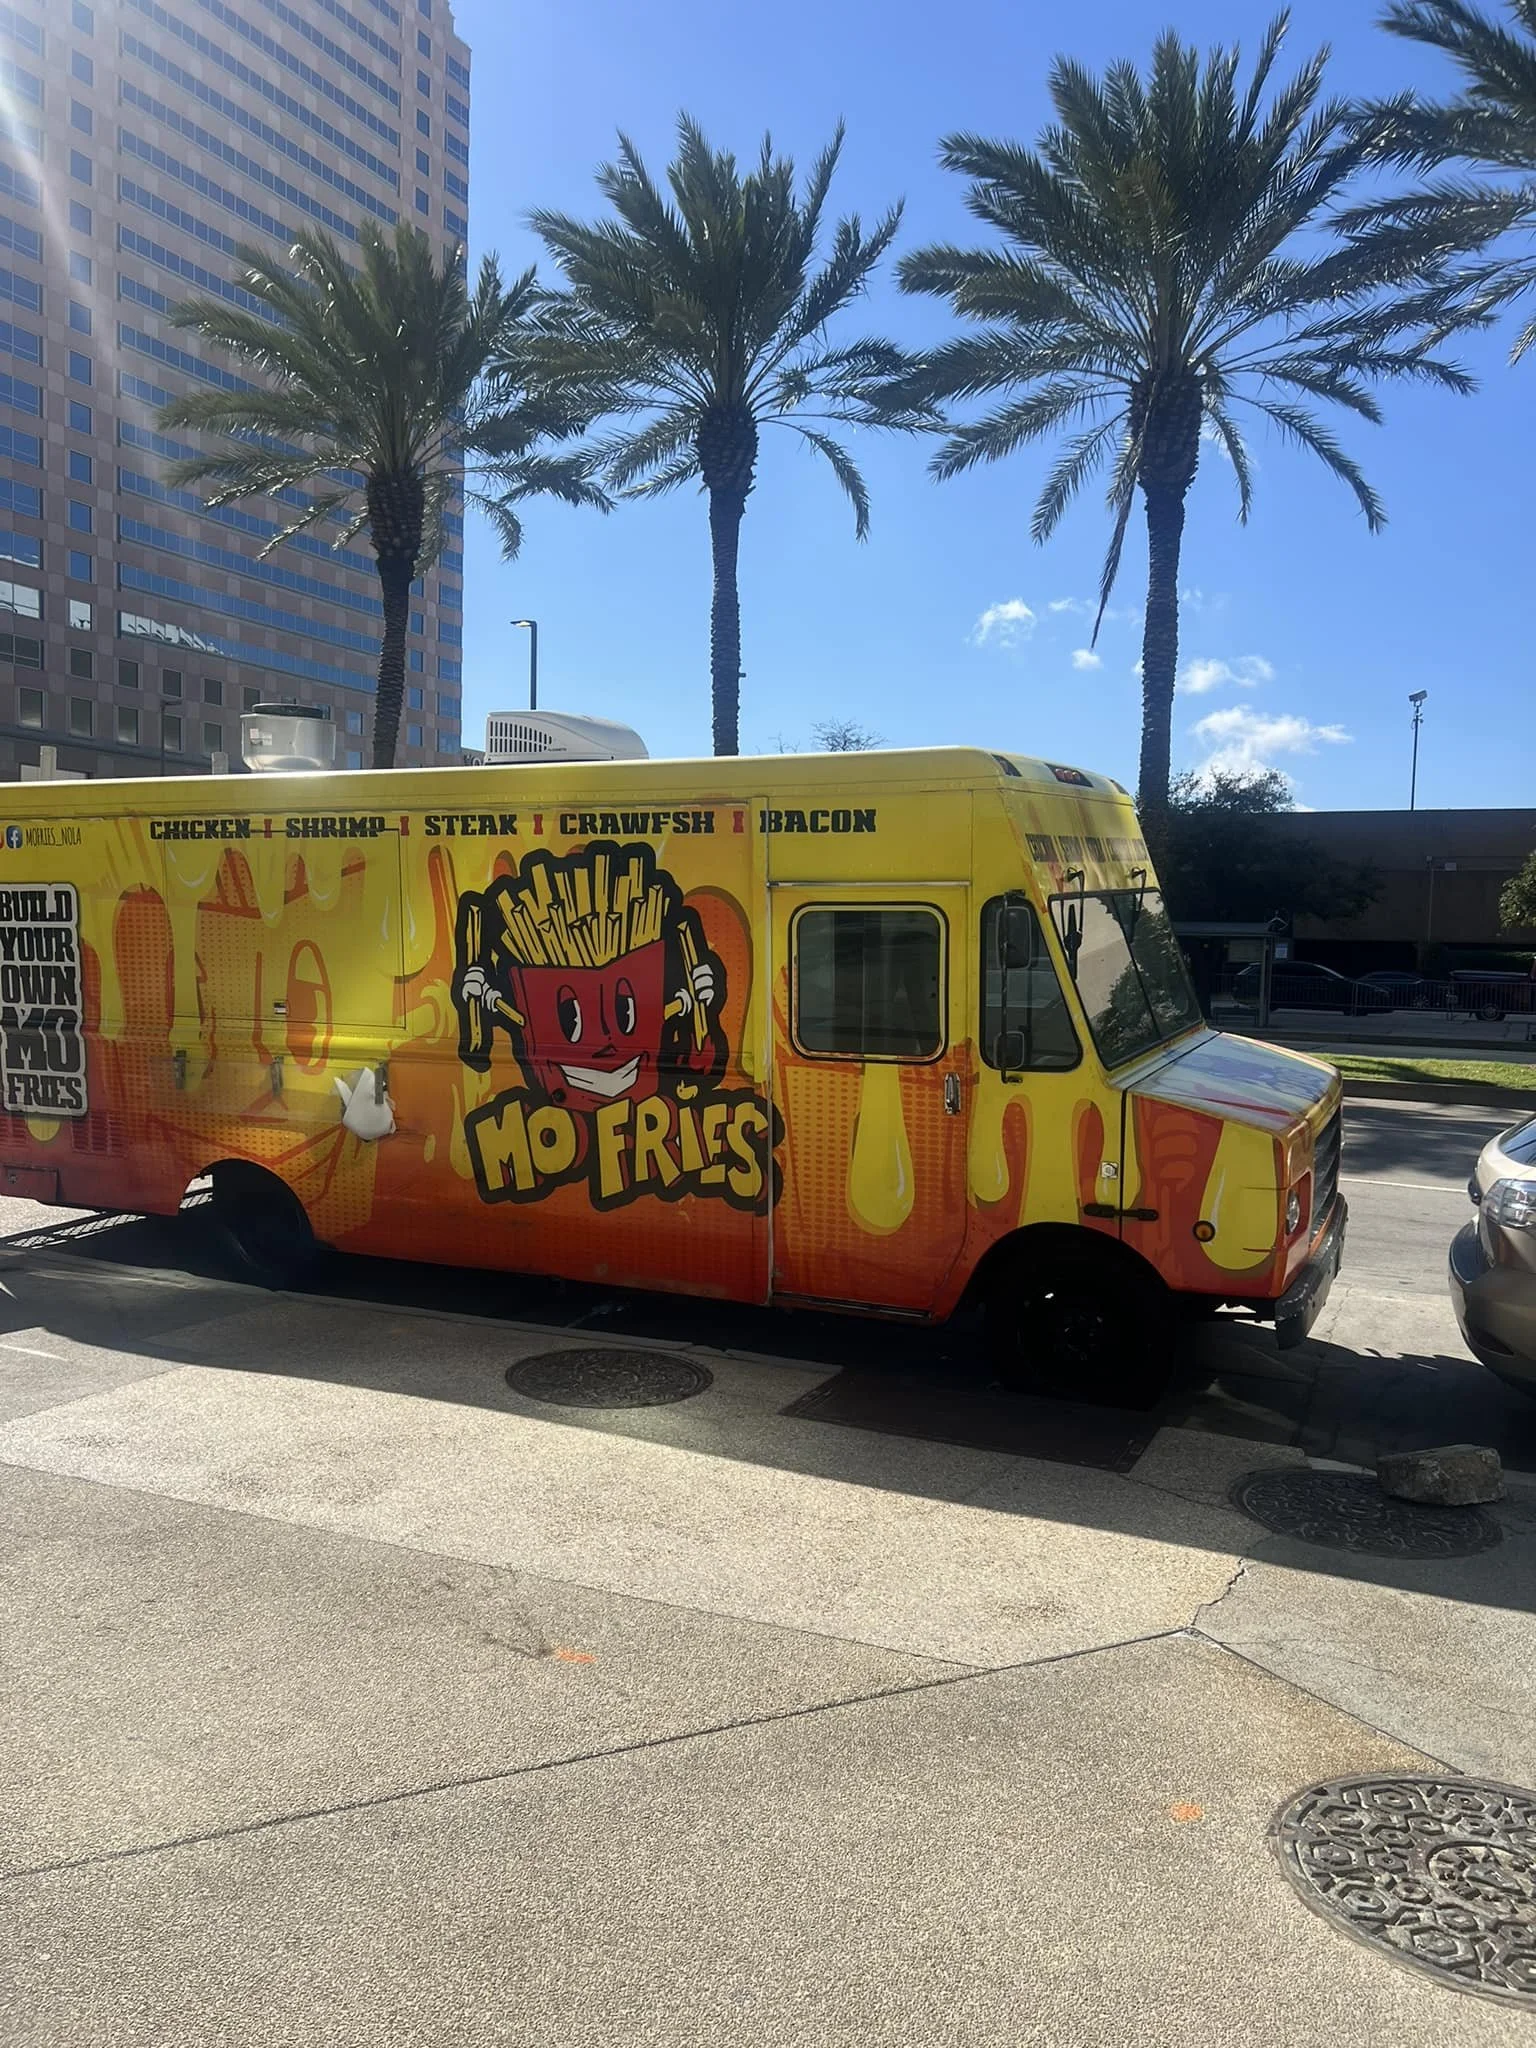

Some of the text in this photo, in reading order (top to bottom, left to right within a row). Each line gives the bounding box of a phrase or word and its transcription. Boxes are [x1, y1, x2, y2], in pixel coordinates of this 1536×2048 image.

[150, 819, 251, 840] CHICKEN
[285, 816, 386, 838] SHRIMP
[424, 814, 518, 836] STEAK
[559, 812, 715, 834] CRAWFSH
[759, 809, 877, 833] BACON
[0, 890, 73, 922] BUILD
[0, 926, 75, 963] YOUR
[1, 964, 78, 1006] OWN
[1, 1006, 81, 1073] MO
[6, 1072, 83, 1109] FRIES
[474, 1099, 576, 1191] MO
